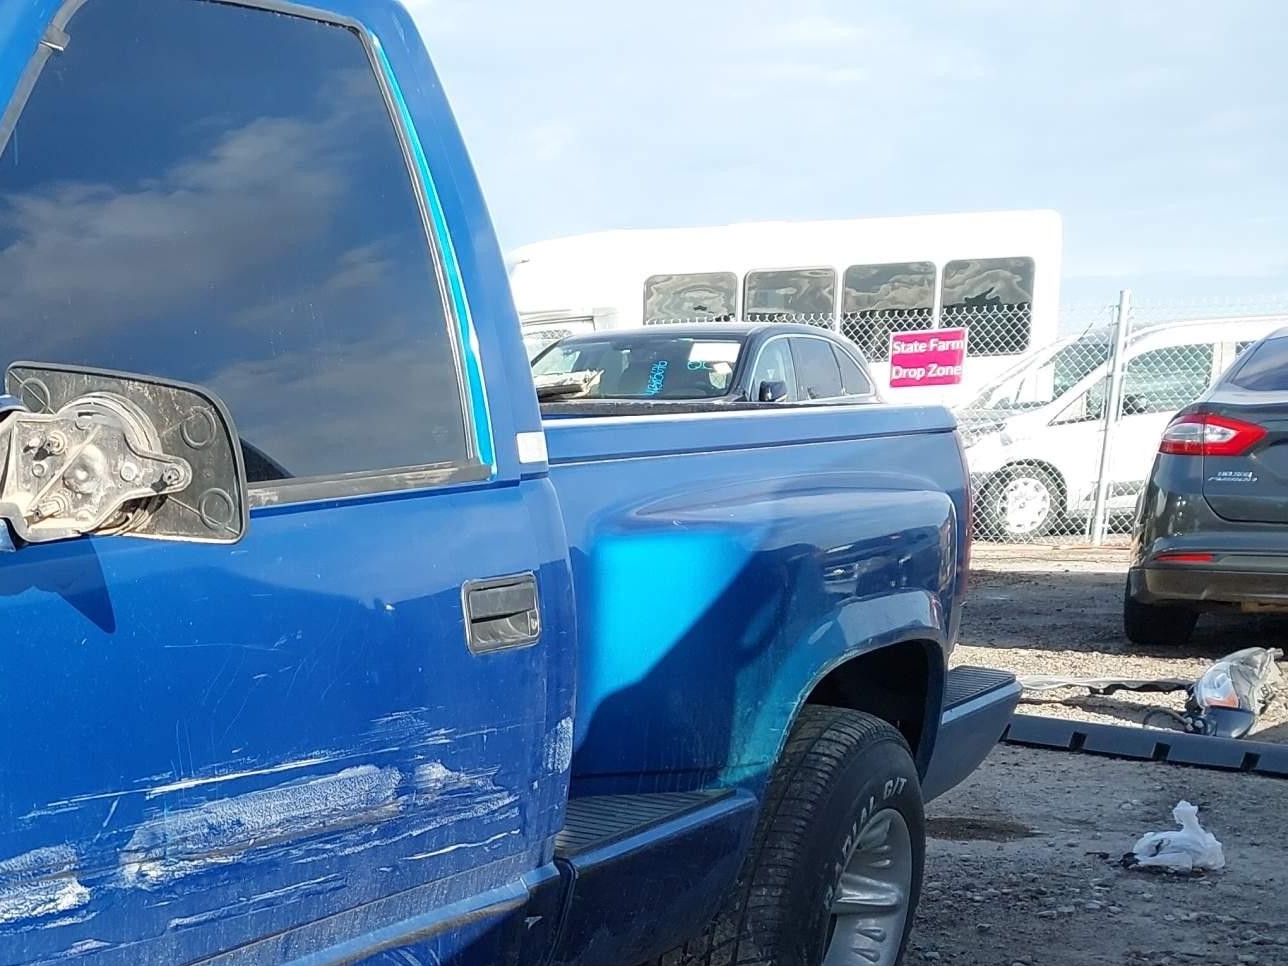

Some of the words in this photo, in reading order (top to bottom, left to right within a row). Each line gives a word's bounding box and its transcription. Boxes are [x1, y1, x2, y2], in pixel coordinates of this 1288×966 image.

[892, 340, 926, 354] State
[928, 337, 963, 352] Farm
[892, 365, 925, 380] Drop
[927, 363, 962, 377] Zone
